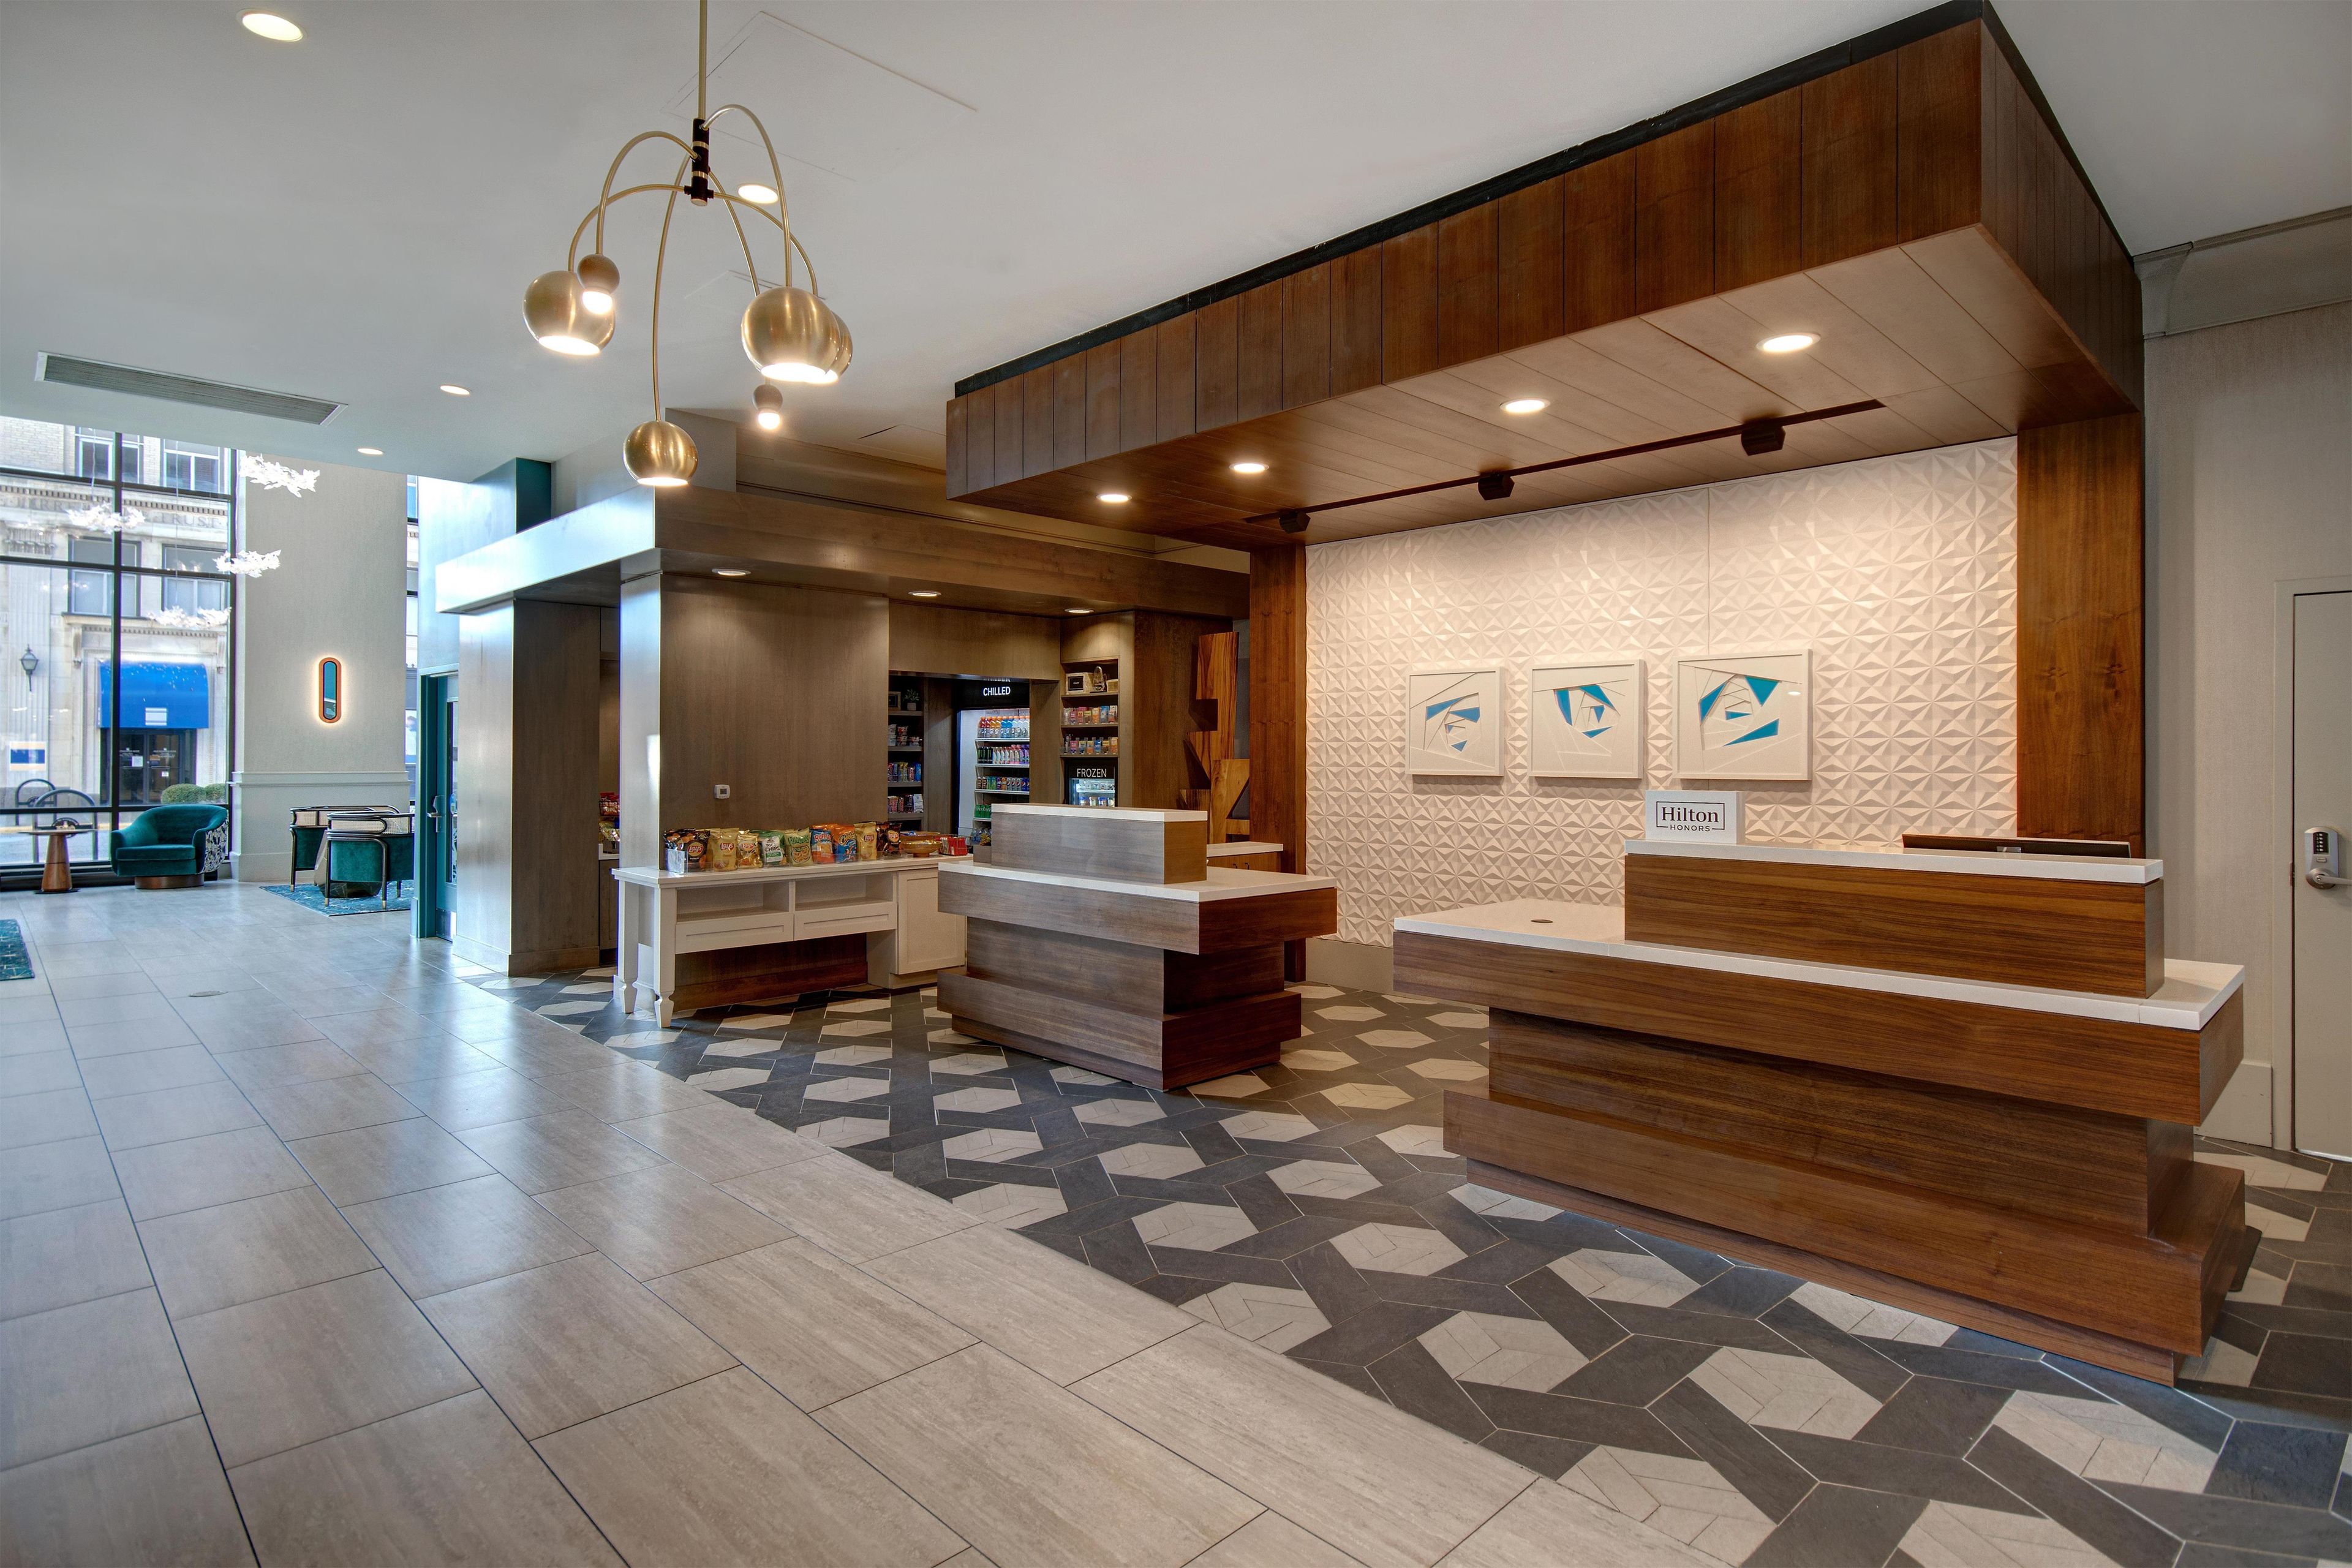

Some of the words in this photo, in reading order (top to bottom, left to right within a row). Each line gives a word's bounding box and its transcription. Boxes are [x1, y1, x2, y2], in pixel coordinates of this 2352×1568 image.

[983, 687, 1011, 696] CHILLED
[1077, 768, 1107, 777] FROZEN
[1662, 807, 1719, 823] Hilton
